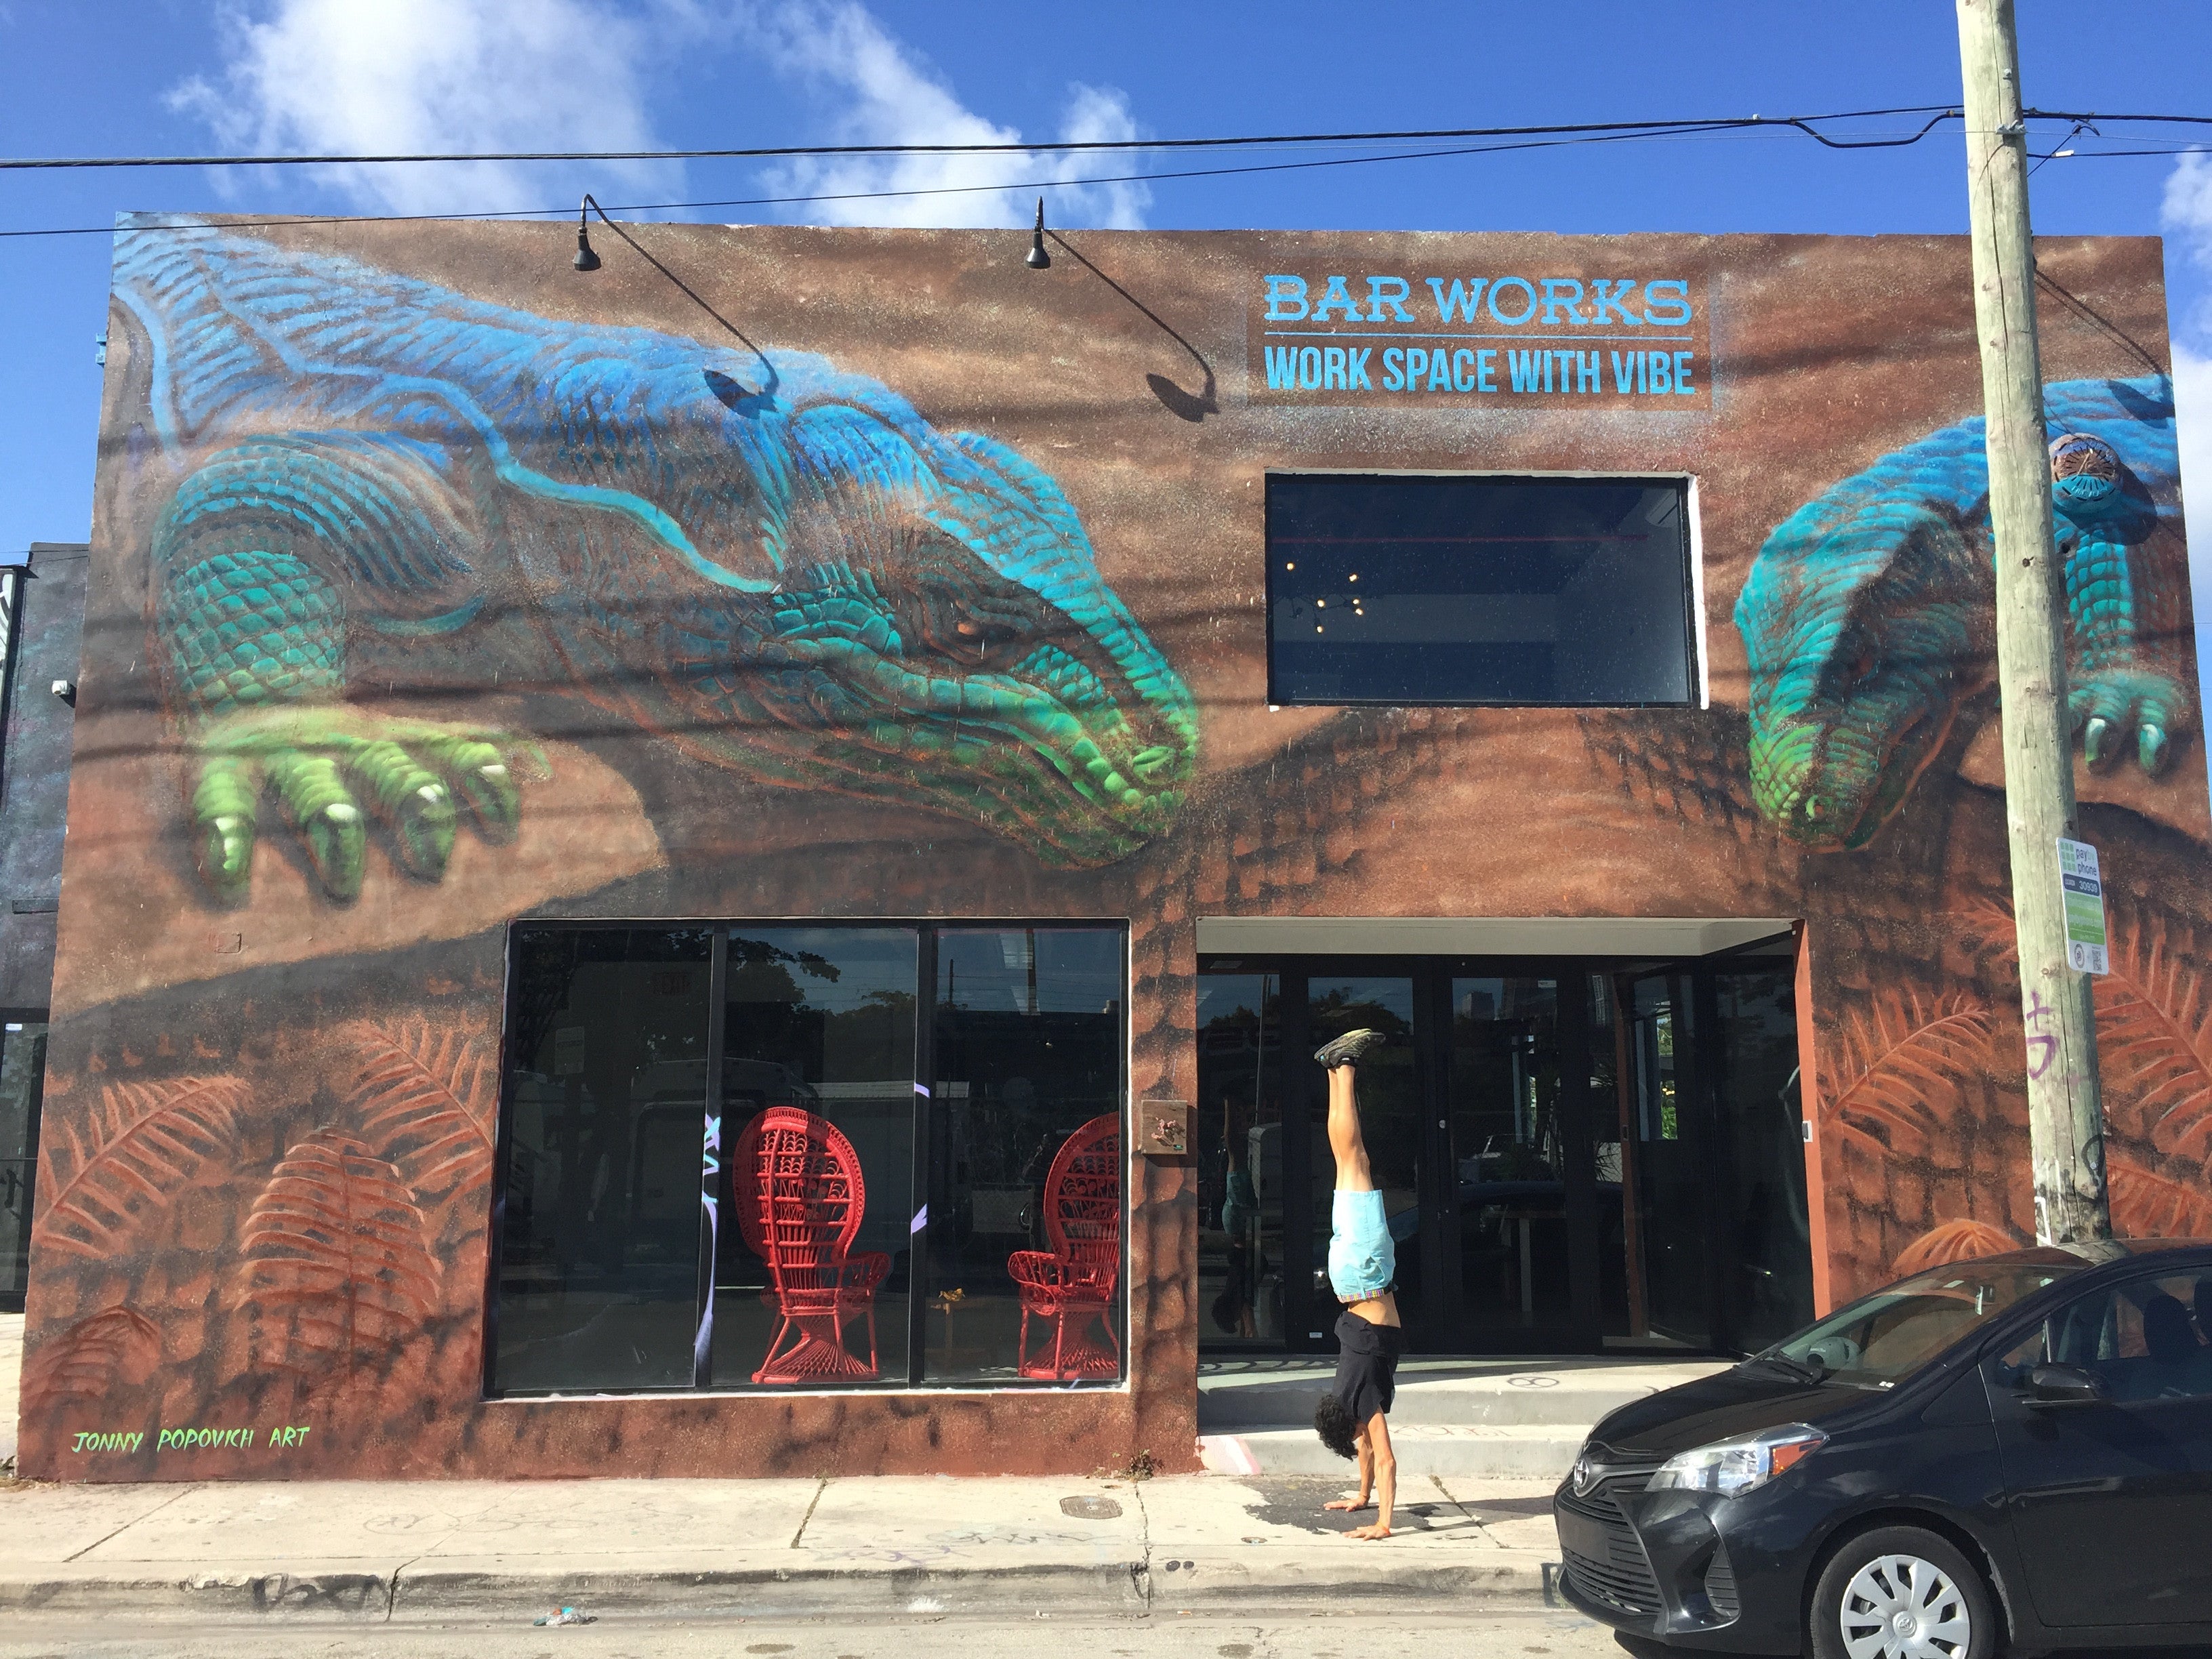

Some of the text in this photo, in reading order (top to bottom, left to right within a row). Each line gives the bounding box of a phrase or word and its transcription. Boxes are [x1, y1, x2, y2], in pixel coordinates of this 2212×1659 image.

[1265, 275, 1692, 325] BAR WORKS
[1265, 346, 1694, 394] WORK SPACE WITH VIBE
[2078, 862, 2097, 876] phone
[71, 1427, 310, 1453] JONNY POPOVICH ART
